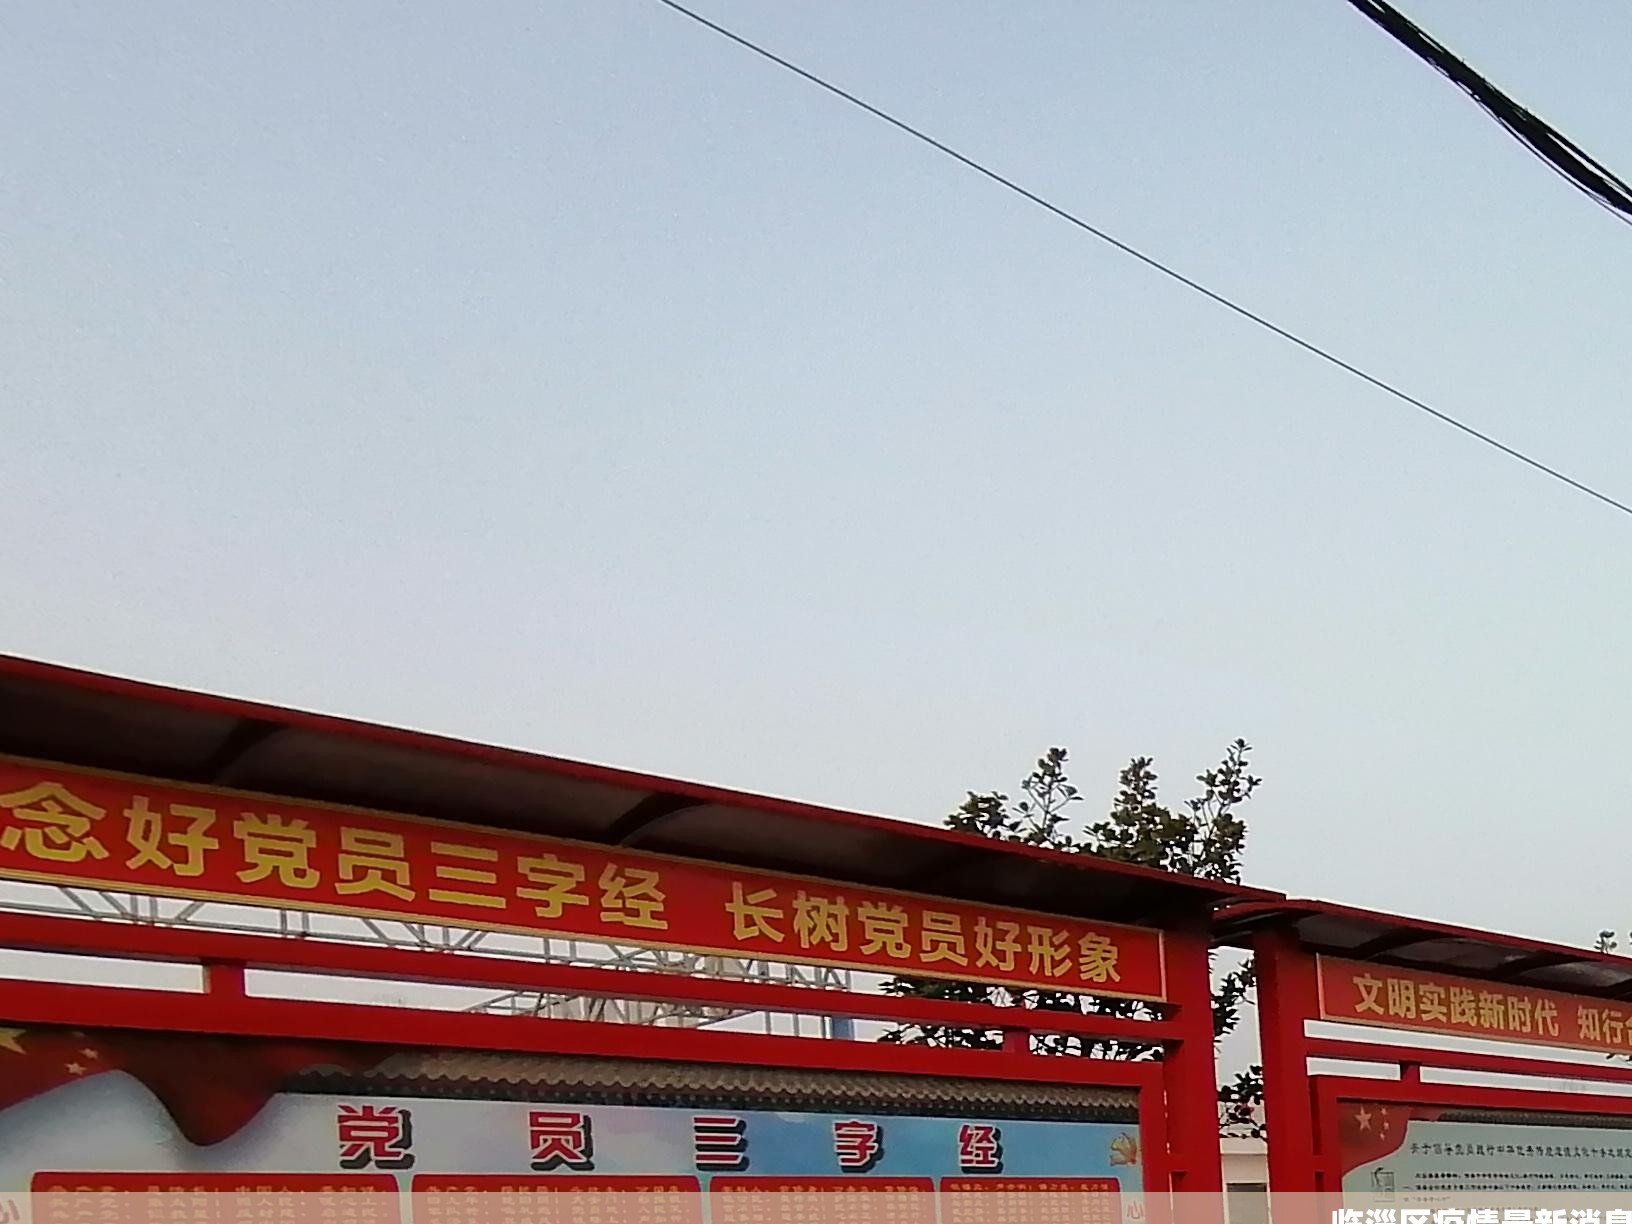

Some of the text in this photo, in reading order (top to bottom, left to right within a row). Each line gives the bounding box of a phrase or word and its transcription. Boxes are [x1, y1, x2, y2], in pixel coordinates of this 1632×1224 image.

[1, 782, 1122, 984] 念好党员三字经 长树党员好形象
[1353, 975, 1559, 1036] 文明实践新时代
[336, 1106, 1003, 1170] 党员三字经
